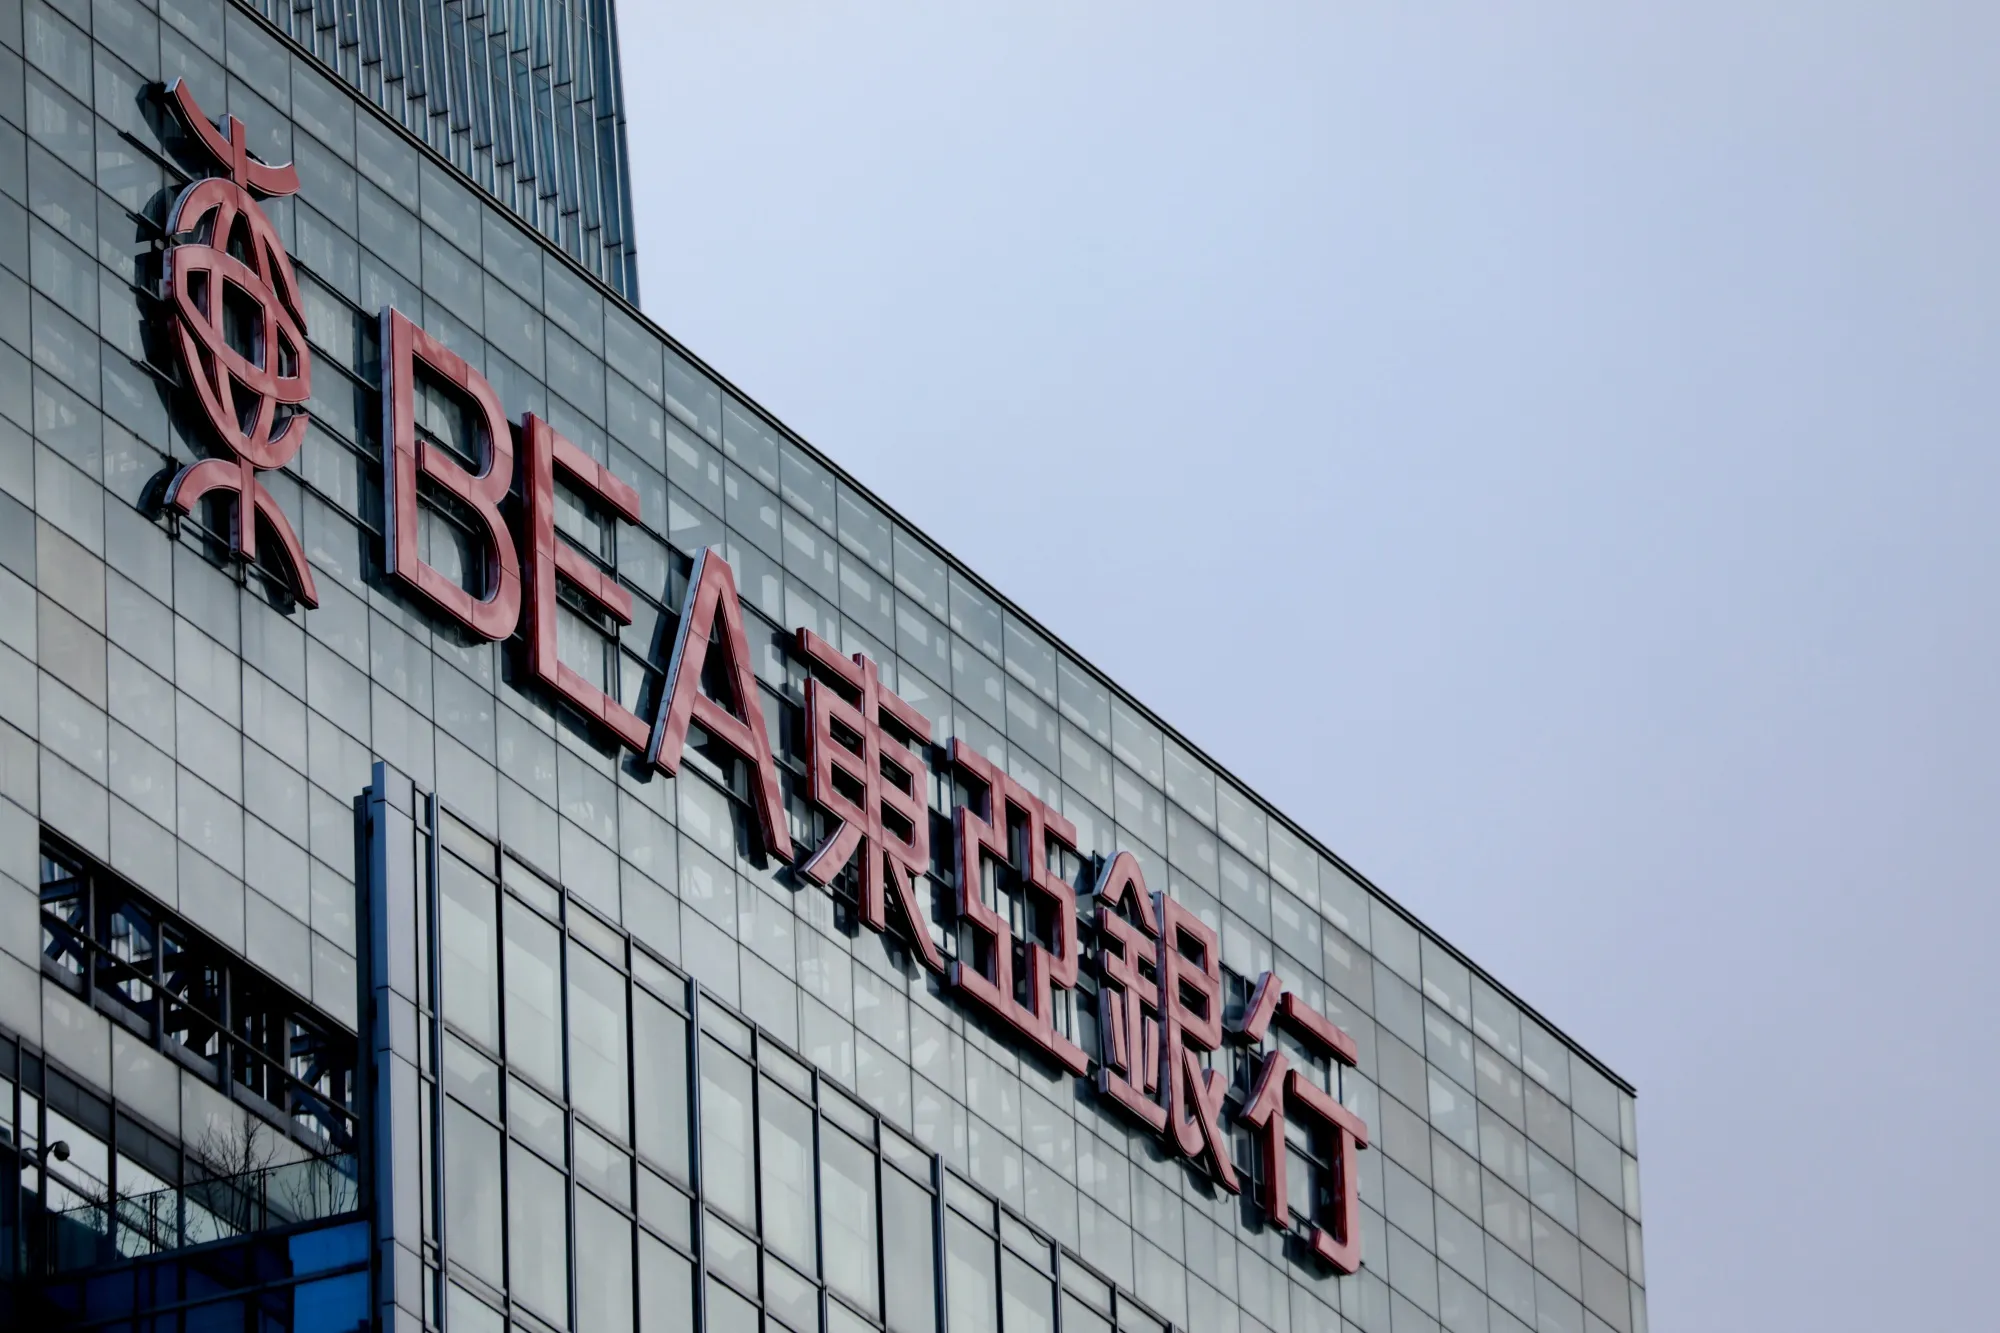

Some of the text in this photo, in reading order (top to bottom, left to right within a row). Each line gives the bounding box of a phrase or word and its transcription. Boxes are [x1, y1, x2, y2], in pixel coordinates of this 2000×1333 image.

[380, 305, 793, 865] BEA
[796, 627, 1368, 1274] 東亞銀行
